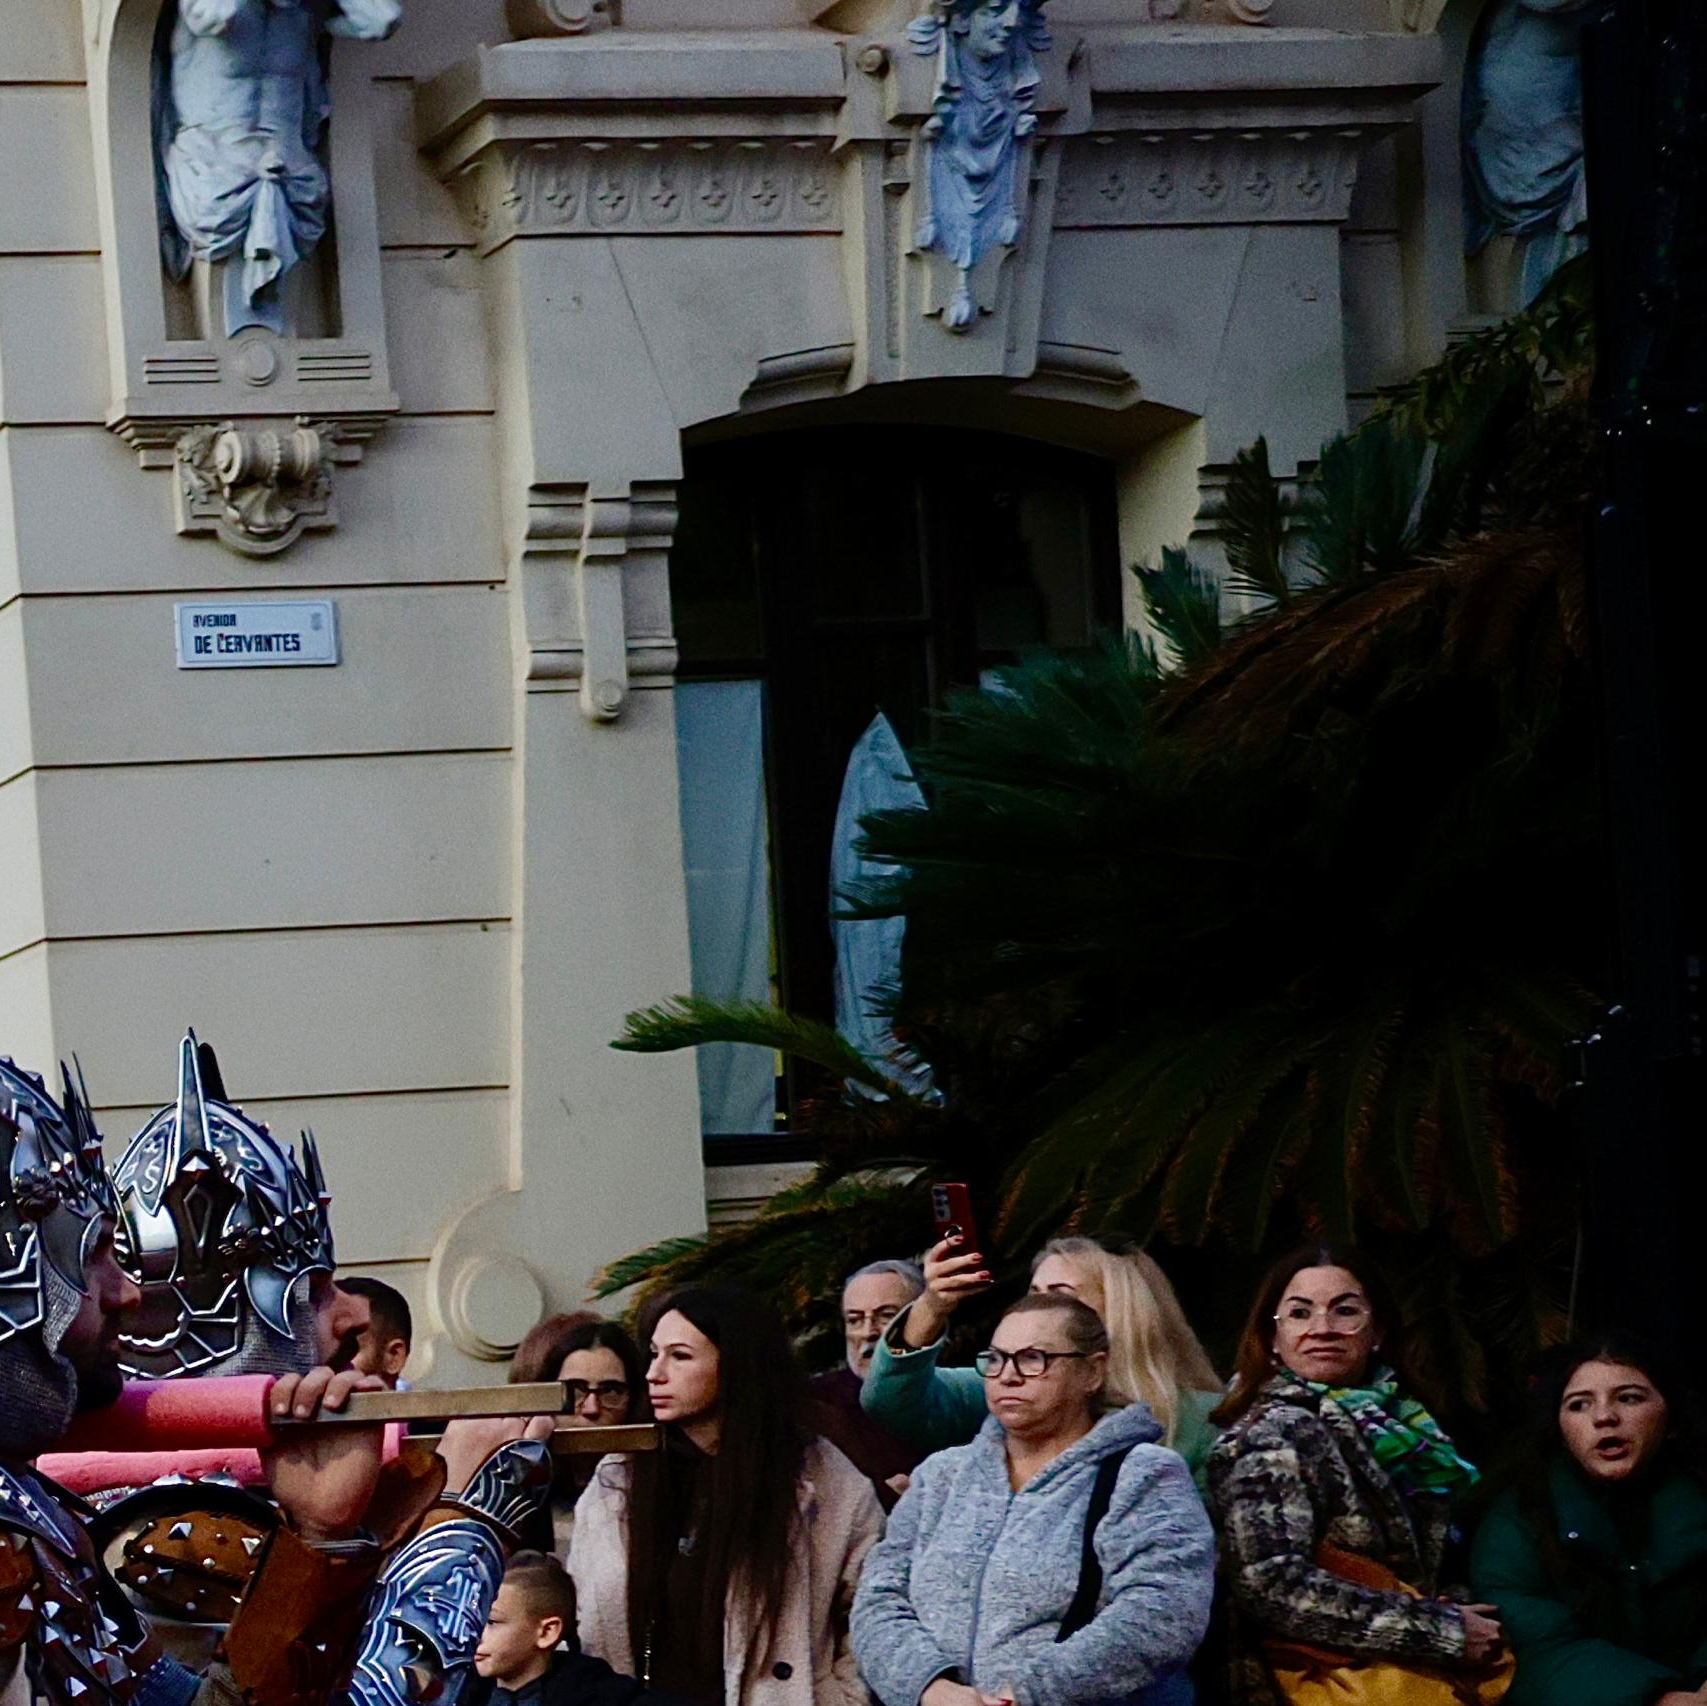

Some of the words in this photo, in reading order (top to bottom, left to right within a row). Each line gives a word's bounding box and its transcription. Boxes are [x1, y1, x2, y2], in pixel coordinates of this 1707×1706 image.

[193, 614, 236, 627] AVENIDA
[194, 635, 212, 654] DE
[217, 633, 301, 653] CERVANTES
